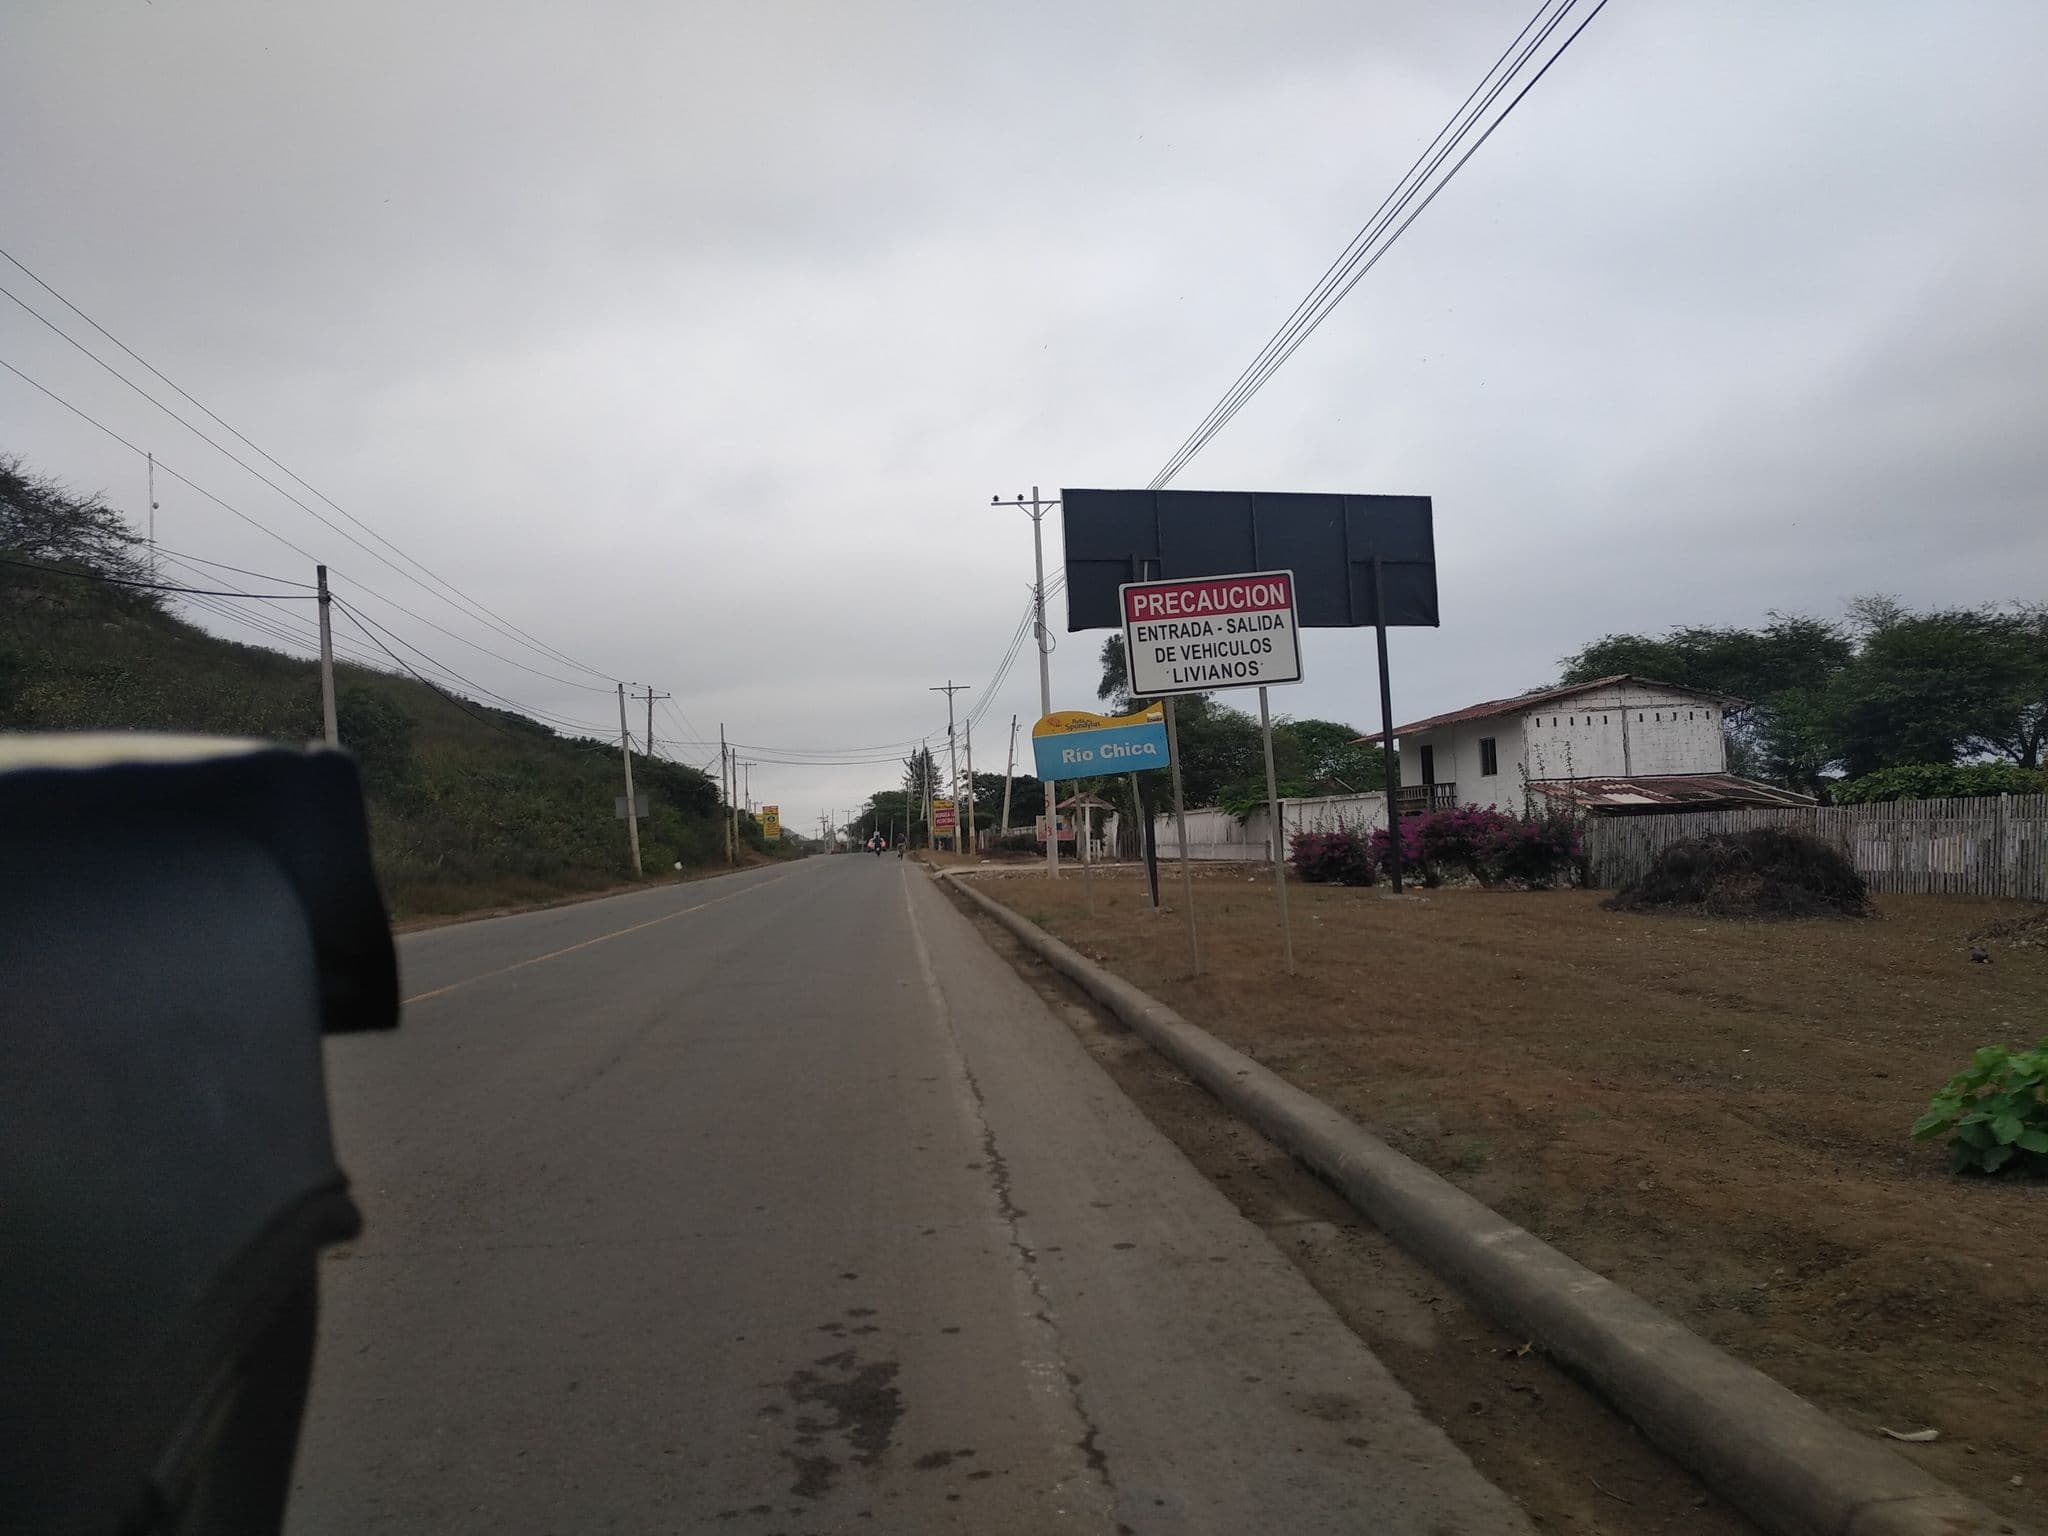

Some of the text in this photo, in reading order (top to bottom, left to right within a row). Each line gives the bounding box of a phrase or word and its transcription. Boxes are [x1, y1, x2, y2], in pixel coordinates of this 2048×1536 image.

[1133, 583, 1286, 617] PRECAUCION
[1137, 621, 1213, 642] ENTRADA
[1227, 614, 1284, 634] SALIDA
[1155, 638, 1272, 663] DE VEHICULOS
[1173, 661, 1260, 684] LIVIANOS
[1062, 742, 1156, 764] Río Chica
